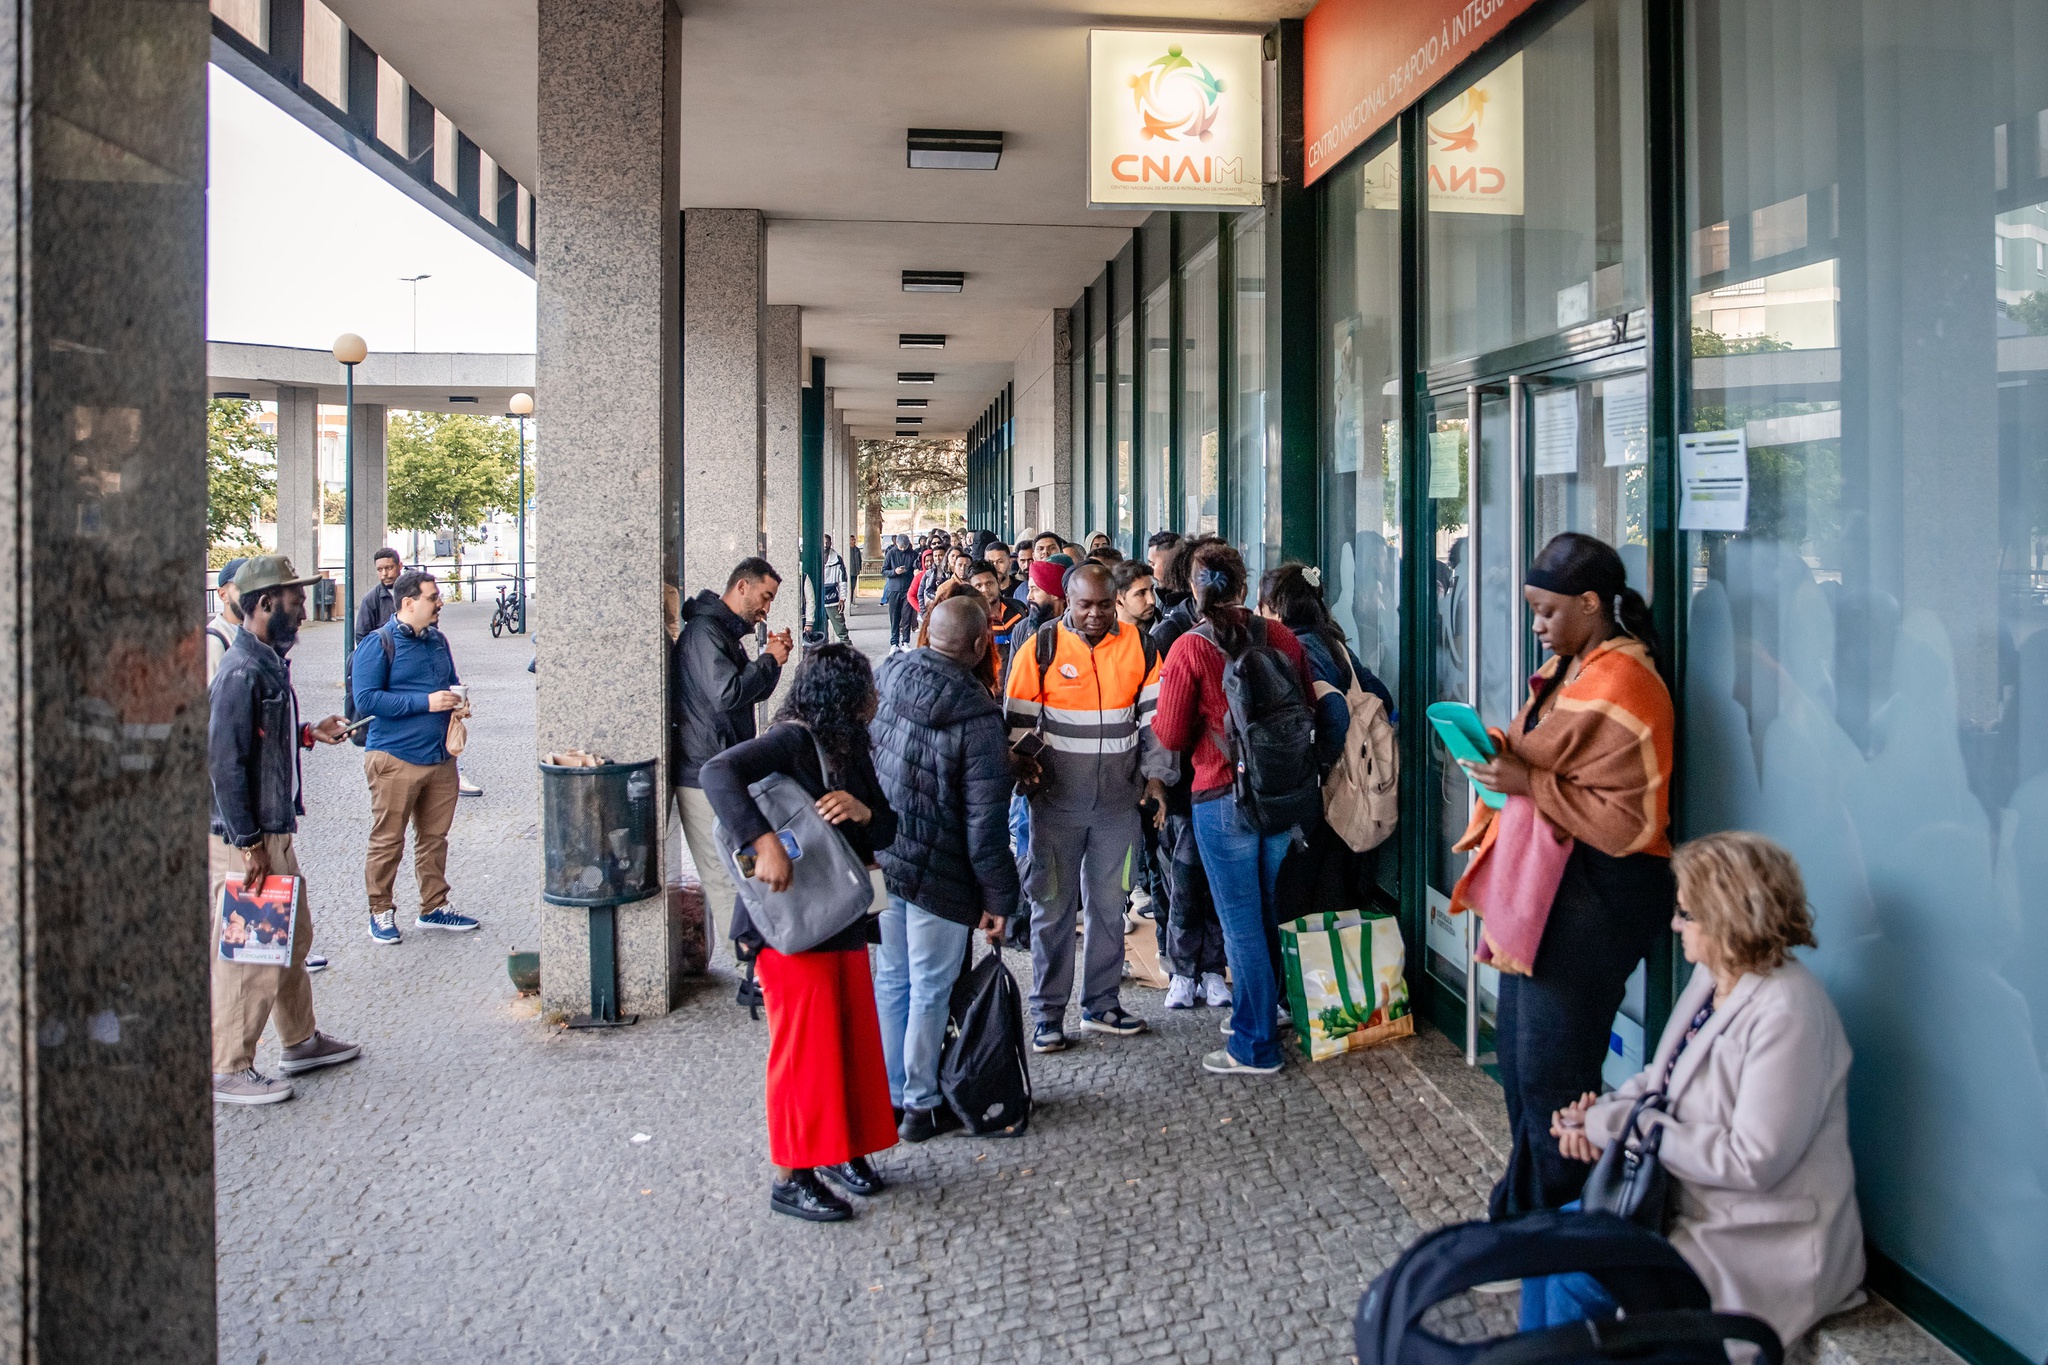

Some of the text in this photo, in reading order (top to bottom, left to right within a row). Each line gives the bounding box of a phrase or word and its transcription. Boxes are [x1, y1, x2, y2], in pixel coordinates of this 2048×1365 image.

[1308, 124, 1339, 168] CENTRO
[1341, 83, 1387, 141] NACIONAL
[1389, 66, 1402, 100] DE
[1403, 36, 1439, 88] APOIO
[1441, 19, 1449, 56] À
[1111, 154, 1243, 184] CNAIM
